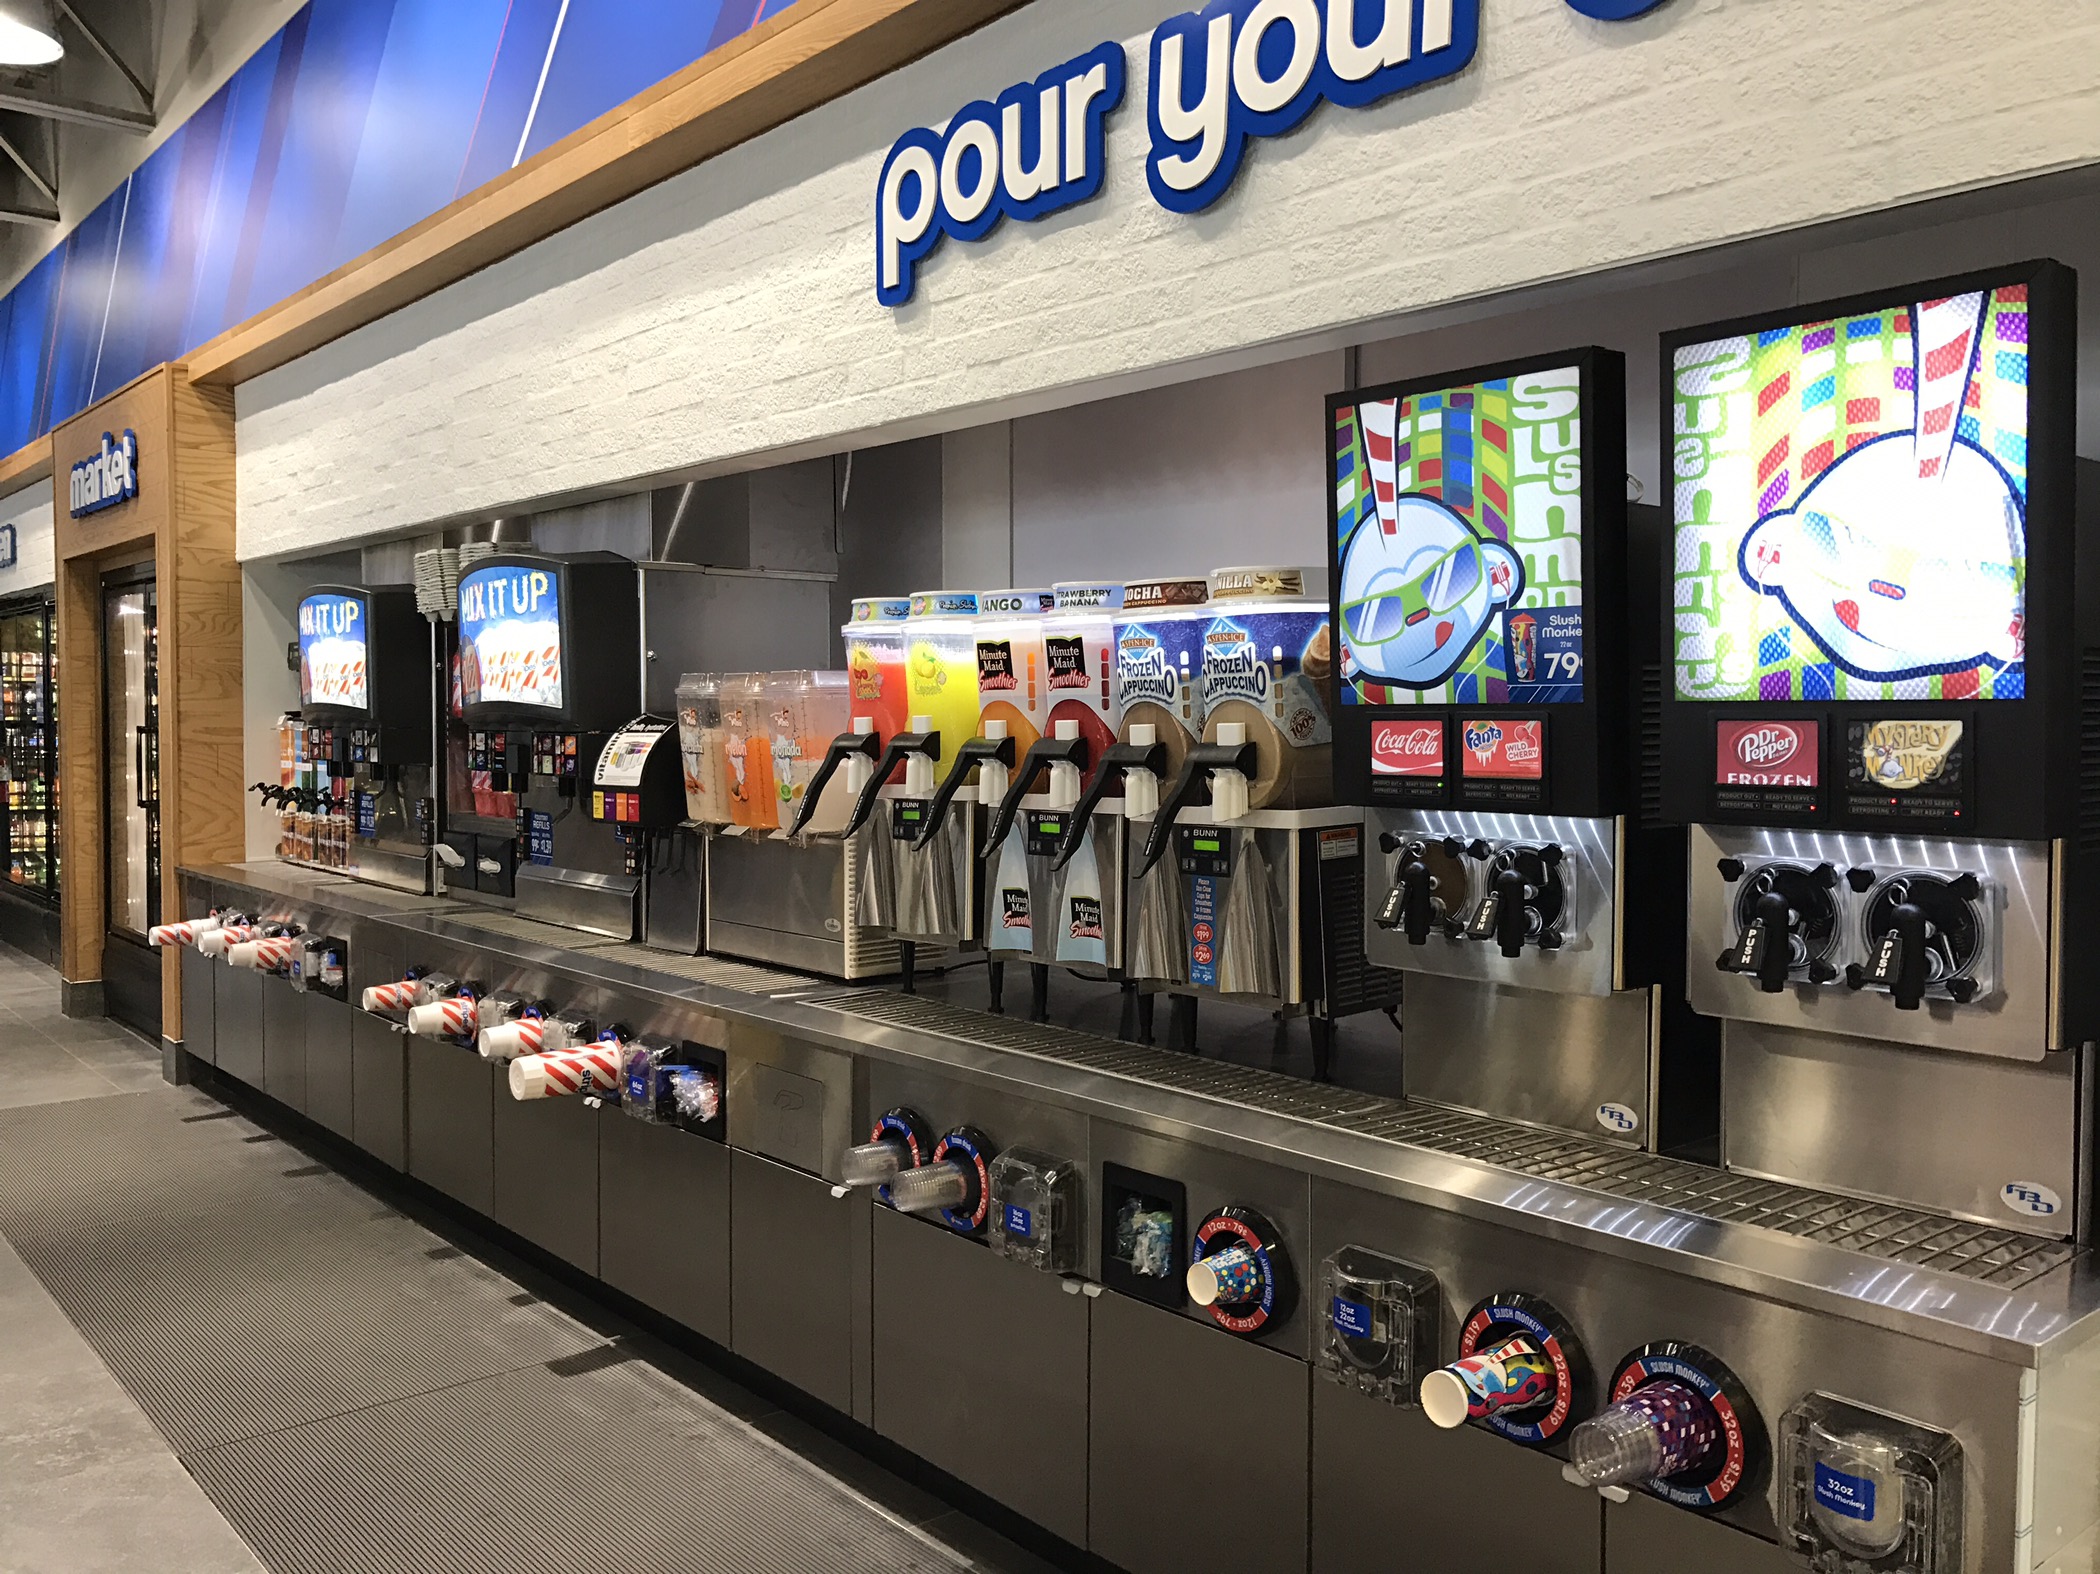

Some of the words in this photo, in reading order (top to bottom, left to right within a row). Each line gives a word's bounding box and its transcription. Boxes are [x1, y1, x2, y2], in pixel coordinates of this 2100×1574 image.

[881, 63, 1106, 289] pour
[70, 435, 133, 512] market
[1056, 589, 1111, 599] TRAWBERRY
[1215, 575, 1253, 590] NILLA
[461, 582, 486, 622] MIX
[488, 577, 508, 618] IT
[512, 571, 548, 614] UP
[1060, 599, 1099, 607] BANANA
[316, 603, 330, 635] IT
[333, 601, 359, 634] UP
[1550, 614, 1582, 626] Slush
[979, 649, 1007, 660] Minute
[1048, 646, 1080, 657] Minute
[1053, 657, 1076, 668] Maid
[1205, 645, 1253, 674] FROZEN
[983, 660, 1005, 671] Maid
[1119, 651, 1163, 678] FROZEN
[979, 670, 1018, 692] Smoothies
[1048, 668, 1091, 691] Smoothies
[1117, 668, 1175, 700] CAPPUCCINO
[1203, 665, 1266, 698] CAPPUCCINO
[1375, 728, 1442, 755] Coca-Cola
[1465, 726, 1502, 751] Fanta
[1507, 743, 1527, 751] WILD
[1738, 733, 1793, 763] Pepper
[1759, 729, 1779, 746] Dr
[1508, 749, 1538, 760] CHERRY
[902, 801, 919, 809] BUNN
[532, 820, 550, 830] REFILLS
[1038, 814, 1059, 822] BUNN
[1193, 829, 1218, 837] BUNN
[1382, 890, 1399, 917] PUSH
[1477, 900, 1492, 930] PUSH
[1080, 912, 1099, 923] Maid
[1742, 929, 1757, 964] PUSH
[1876, 941, 1893, 977] PUSH
[1207, 1221, 1226, 1233] 12oz
[1339, 1311, 1356, 1323] 22oz
[1340, 1303, 1355, 1315] 12oz
[1493, 1308, 1514, 1319] SLUSH
[1514, 1310, 1541, 1333] MONKEY
[1553, 1353, 1567, 1387] 22oz
[1650, 1361, 1674, 1374] SLUSH
[1674, 1364, 1706, 1389] MONKEY
[1721, 1410, 1740, 1449] 32oz
[1720, 1460, 1741, 1493] $1.39
[1827, 1478, 1854, 1496] 32oz
[1817, 1484, 1834, 1500] Slush
[1834, 1493, 1867, 1511] Monkey
